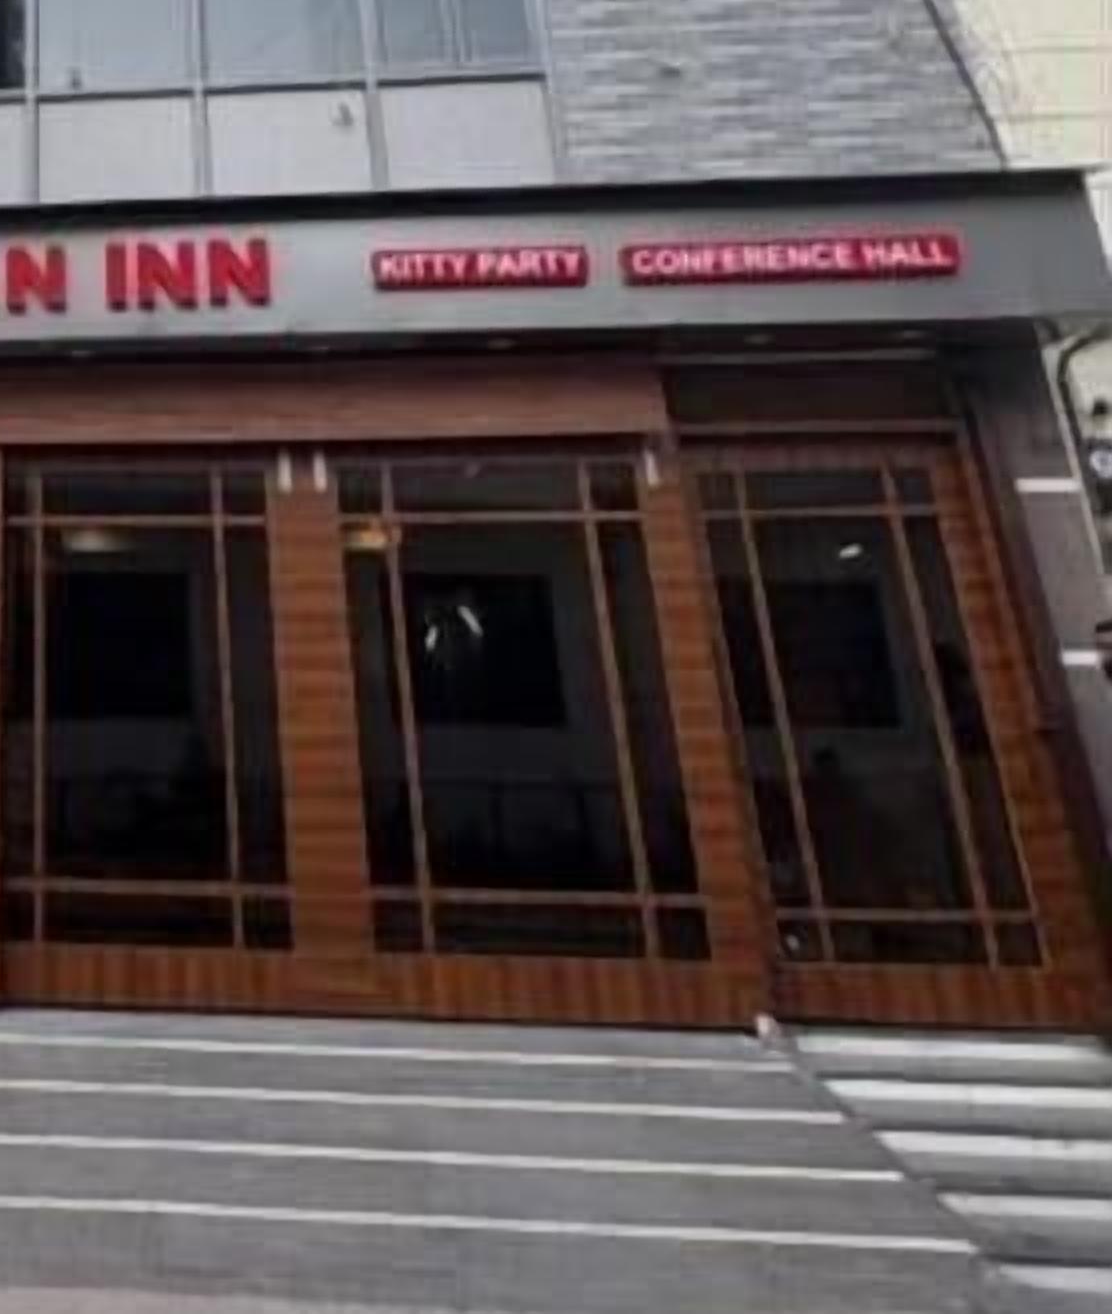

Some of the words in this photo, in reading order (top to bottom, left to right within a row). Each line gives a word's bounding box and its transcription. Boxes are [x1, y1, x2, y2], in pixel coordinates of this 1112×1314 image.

[103, 234, 274, 312] INN
[380, 252, 467, 280] KITTY
[477, 249, 579, 278] PARTY
[631, 244, 852, 274] CONFERENCE
[860, 240, 953, 268] HALL
